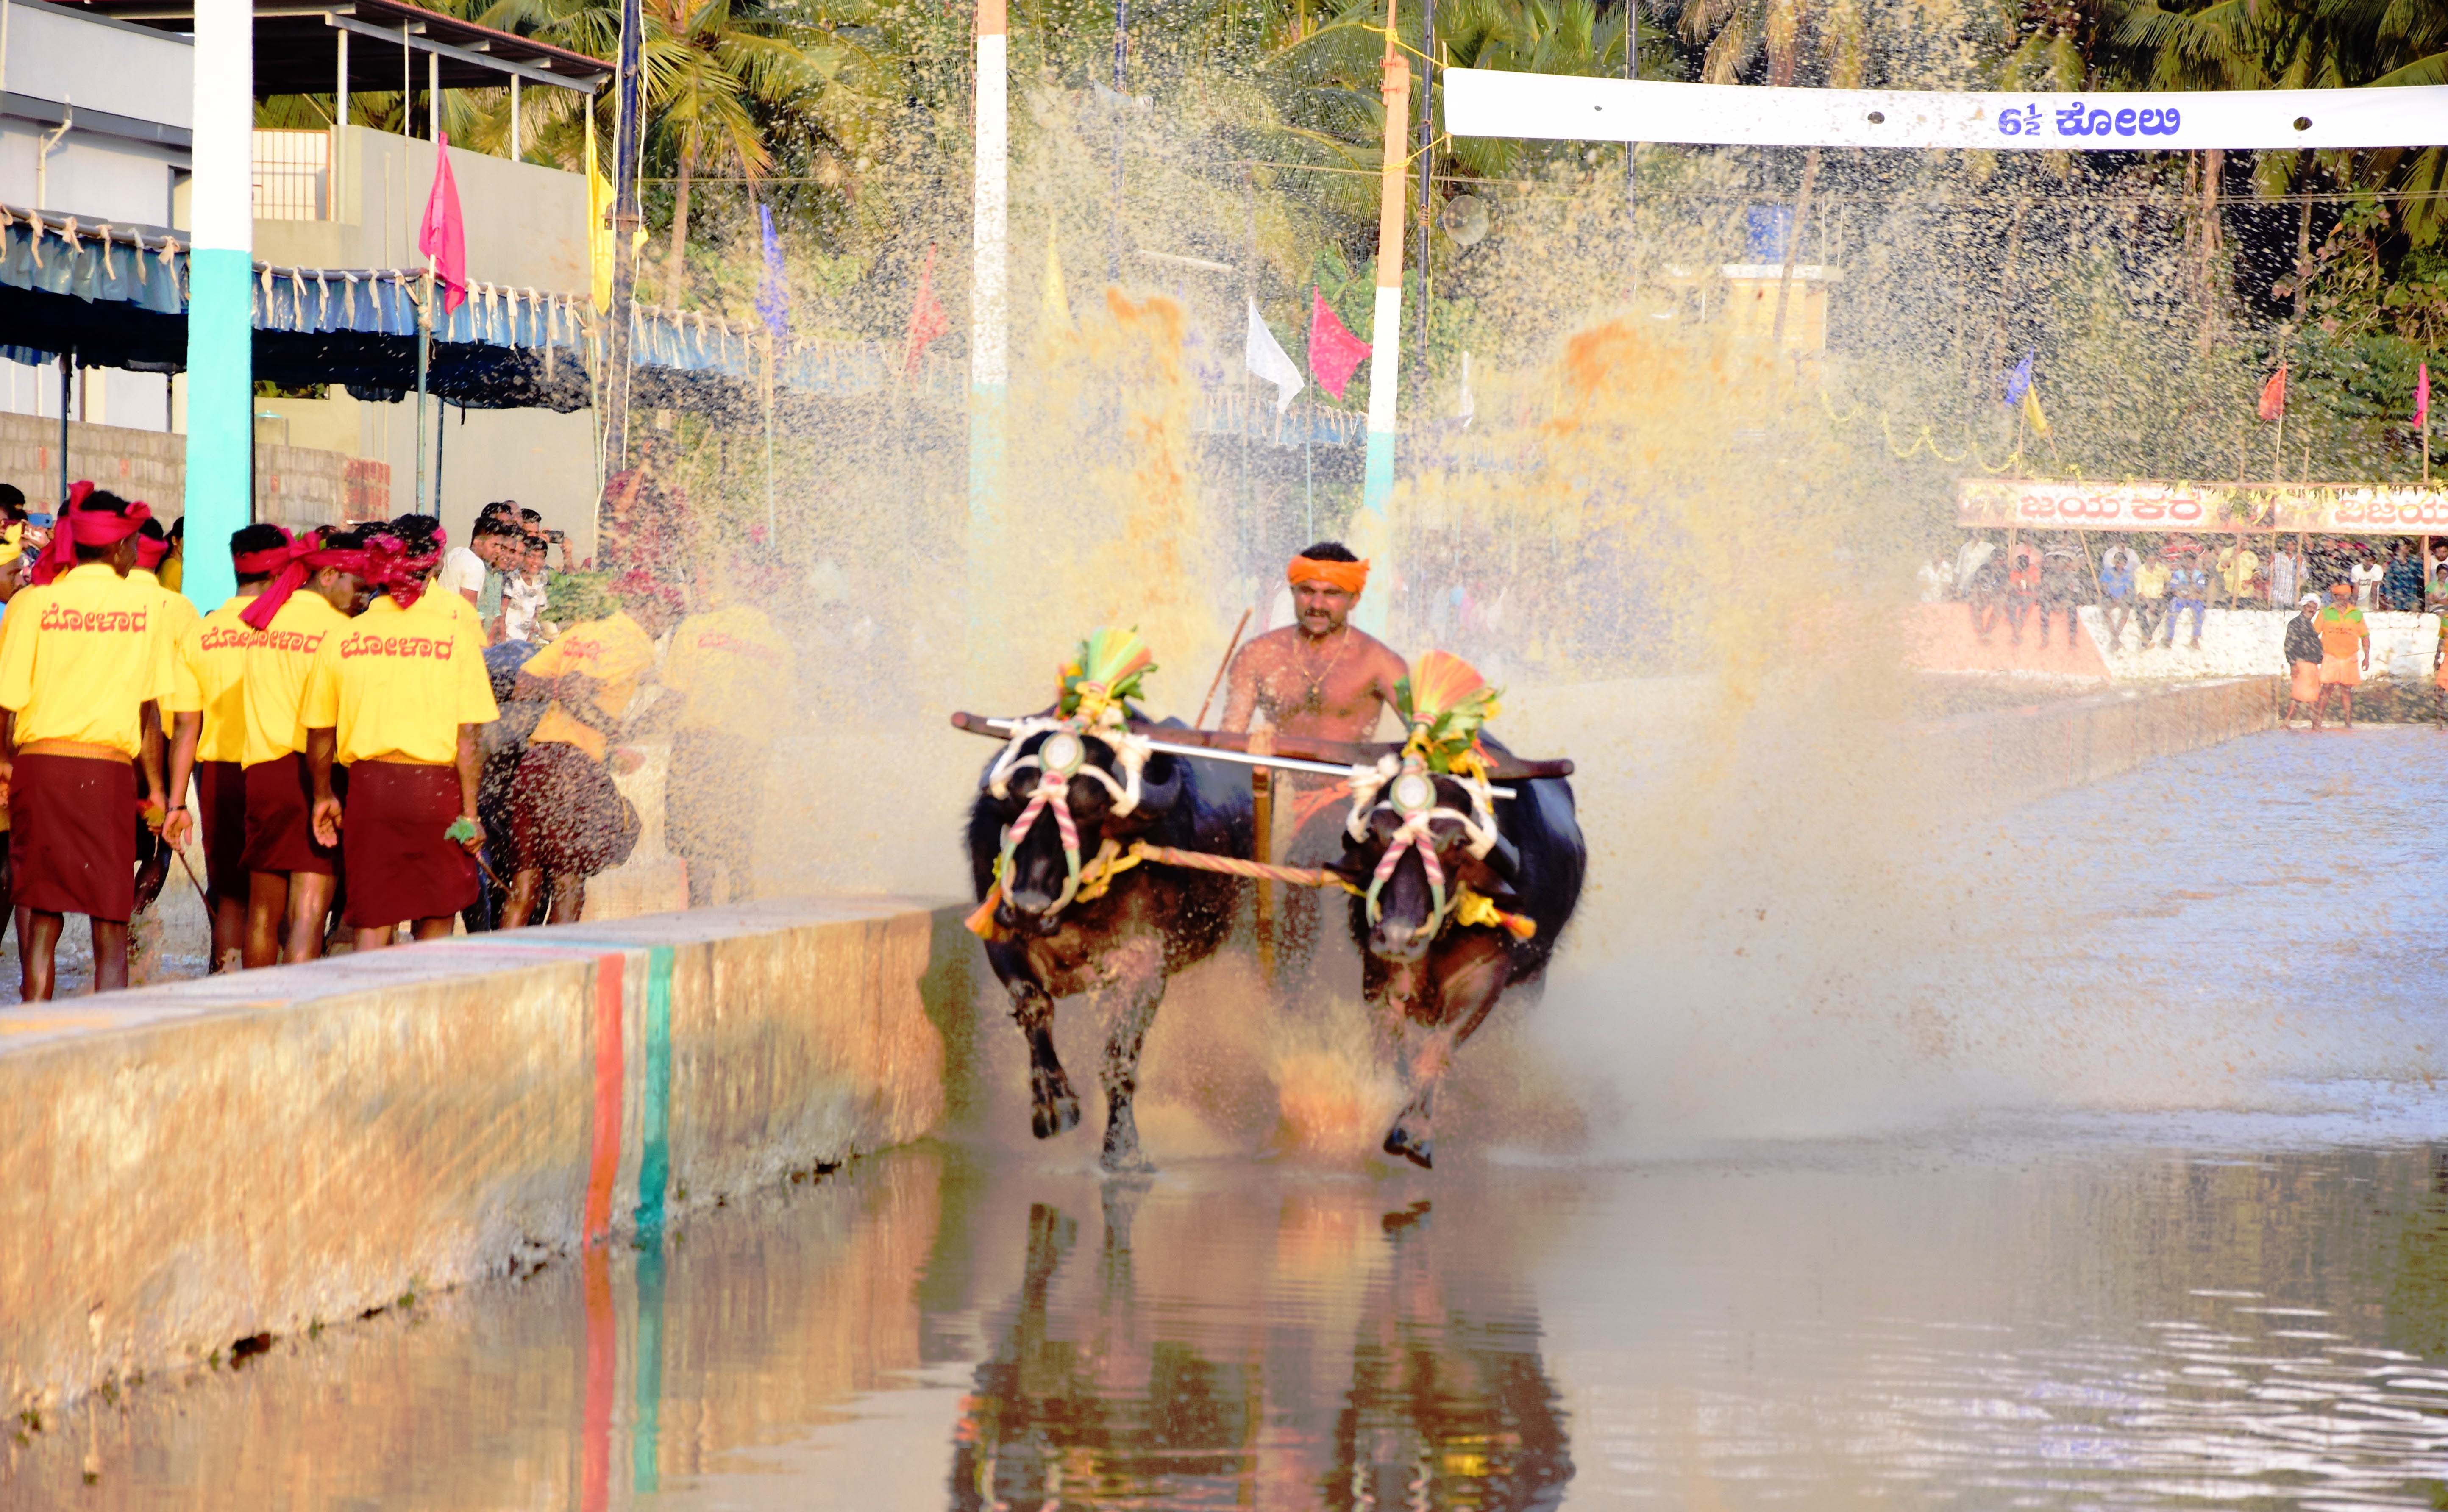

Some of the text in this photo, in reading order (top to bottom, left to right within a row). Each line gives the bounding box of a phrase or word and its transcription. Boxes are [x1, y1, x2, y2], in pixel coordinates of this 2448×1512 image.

[2056, 102, 2180, 136] ಕೋಲು
[2021, 495, 2120, 518] ಜಯ
[41, 602, 147, 633] ಬೋಳಾರ
[340, 631, 454, 661] ಬೋಳಾರ
